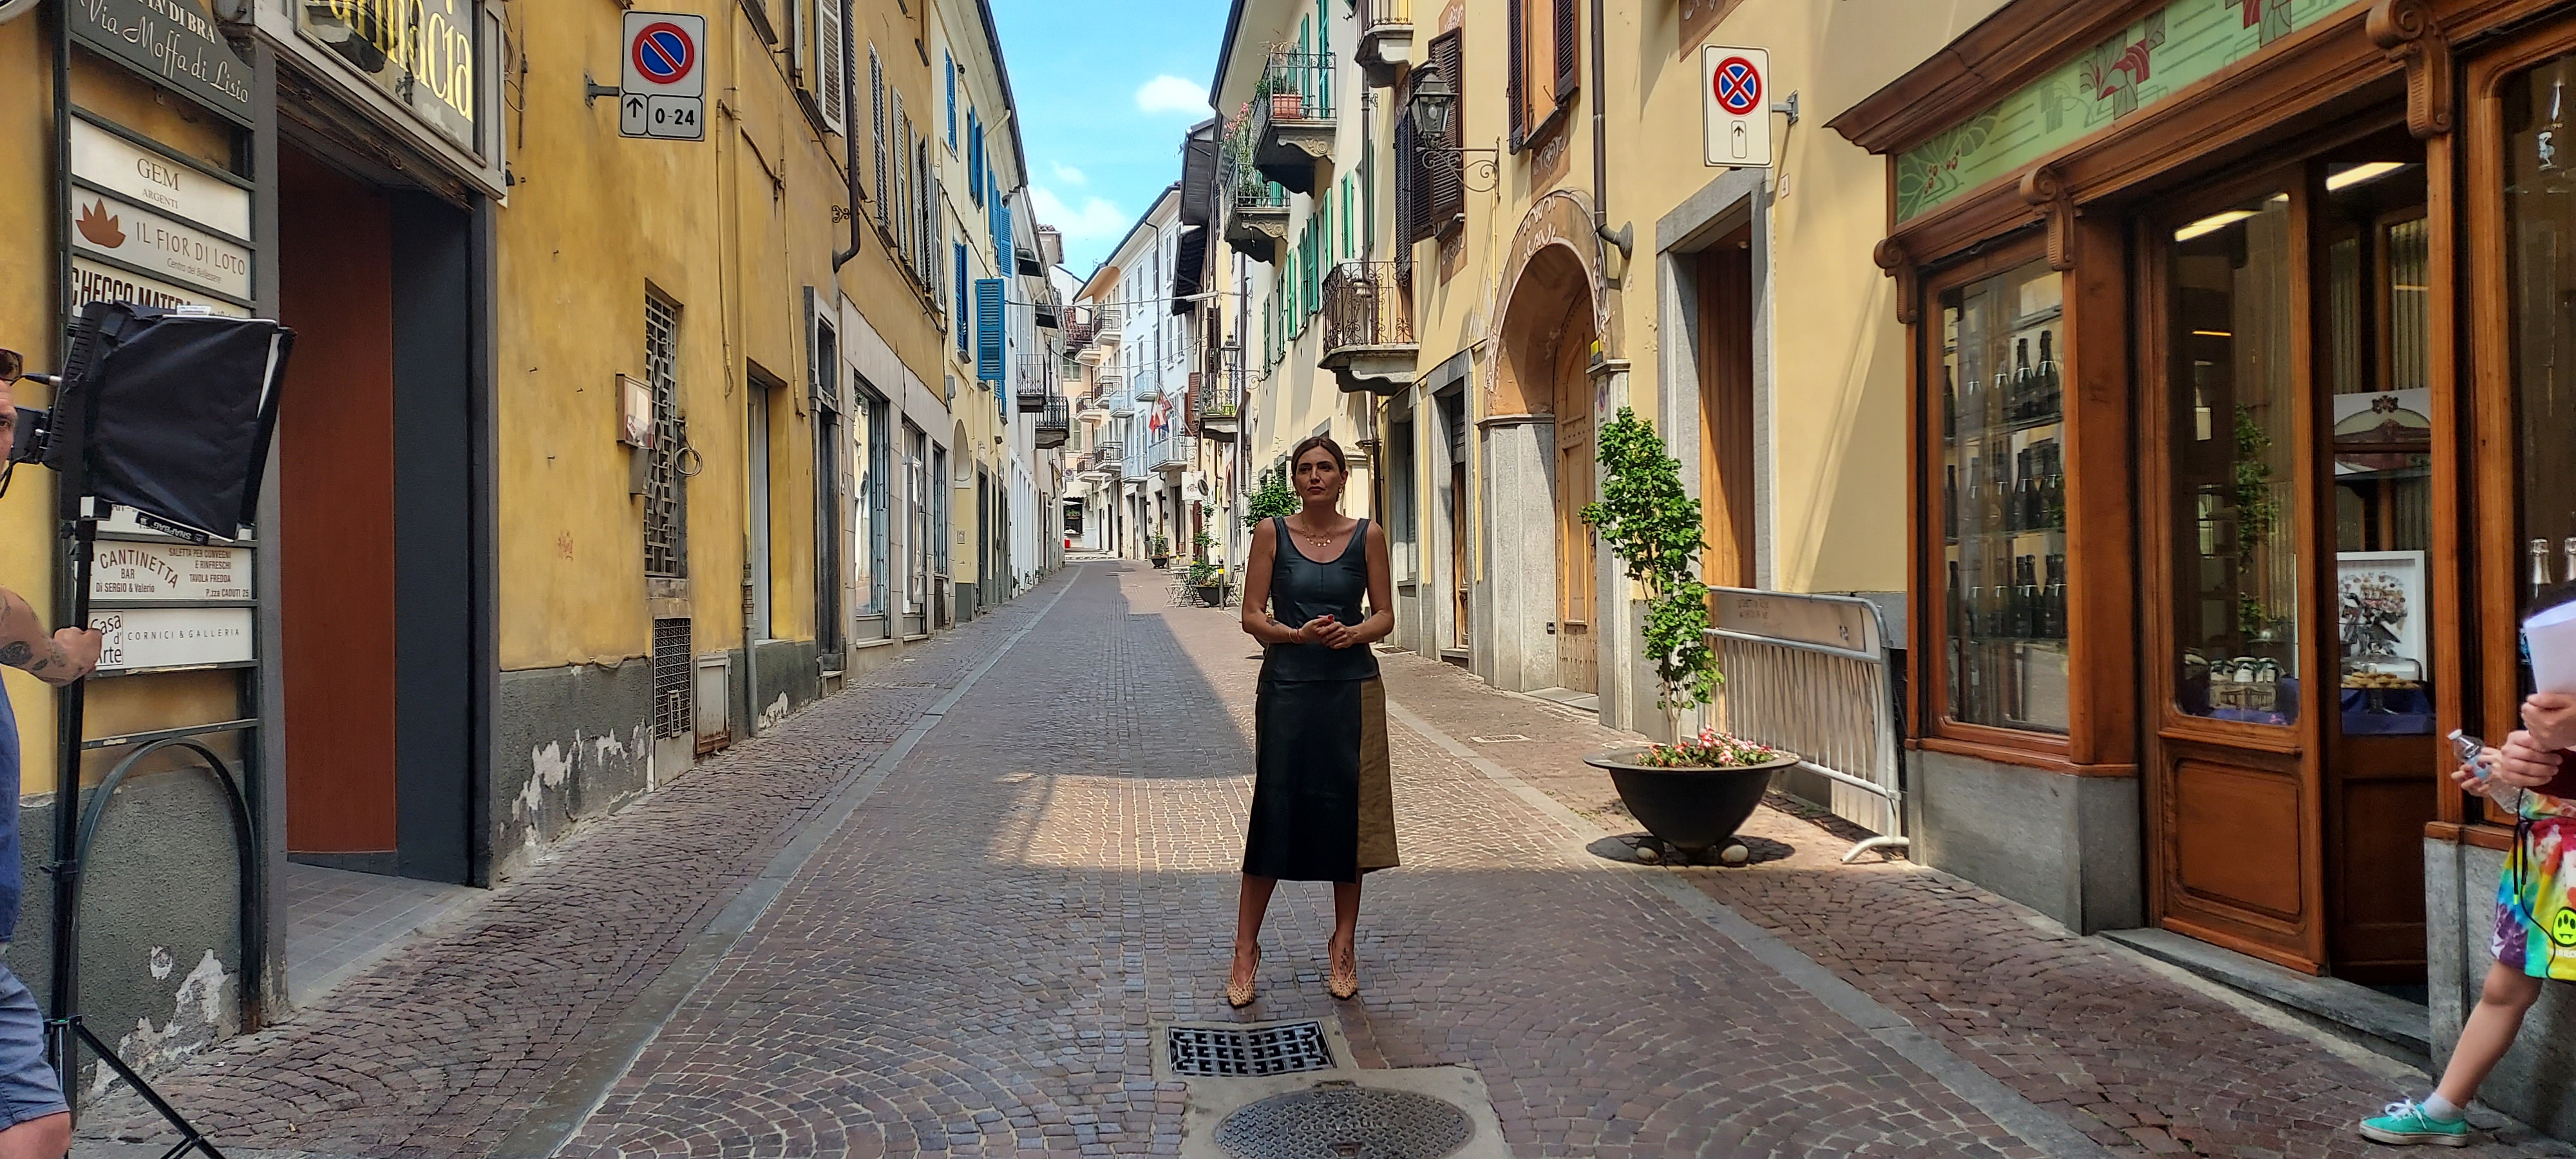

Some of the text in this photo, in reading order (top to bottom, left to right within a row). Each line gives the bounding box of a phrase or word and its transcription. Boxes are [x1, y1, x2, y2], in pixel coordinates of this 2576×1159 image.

[169, 2, 185, 26] DI
[187, 11, 216, 44] BRA
[79, 0, 249, 103] Via Moffa di Lisio
[655, 108, 695, 126] 0-24
[137, 158, 180, 192] GEM
[142, 188, 178, 209] ARGENTI
[136, 221, 245, 276] IL FIOR DI LOTO
[167, 258, 222, 284] Centro del Bellessere
[153, 521, 192, 540] SNAPBAG
[169, 547, 231, 559] SALETTA PER CONVEGNI
[100, 549, 178, 589] CANTINETTA
[195, 560, 231, 570] E RINFRESCHI
[121, 569, 135, 580] BAR
[189, 574, 231, 583] TAVOLA FREDDA
[104, 582, 127, 592] SERGIO
[129, 583, 133, 592] &
[135, 583, 155, 592] Valerio
[205, 589, 220, 597] P.zza
[222, 589, 241, 597] CADUTI
[128, 628, 239, 641] CORNICI & GALLERIA
